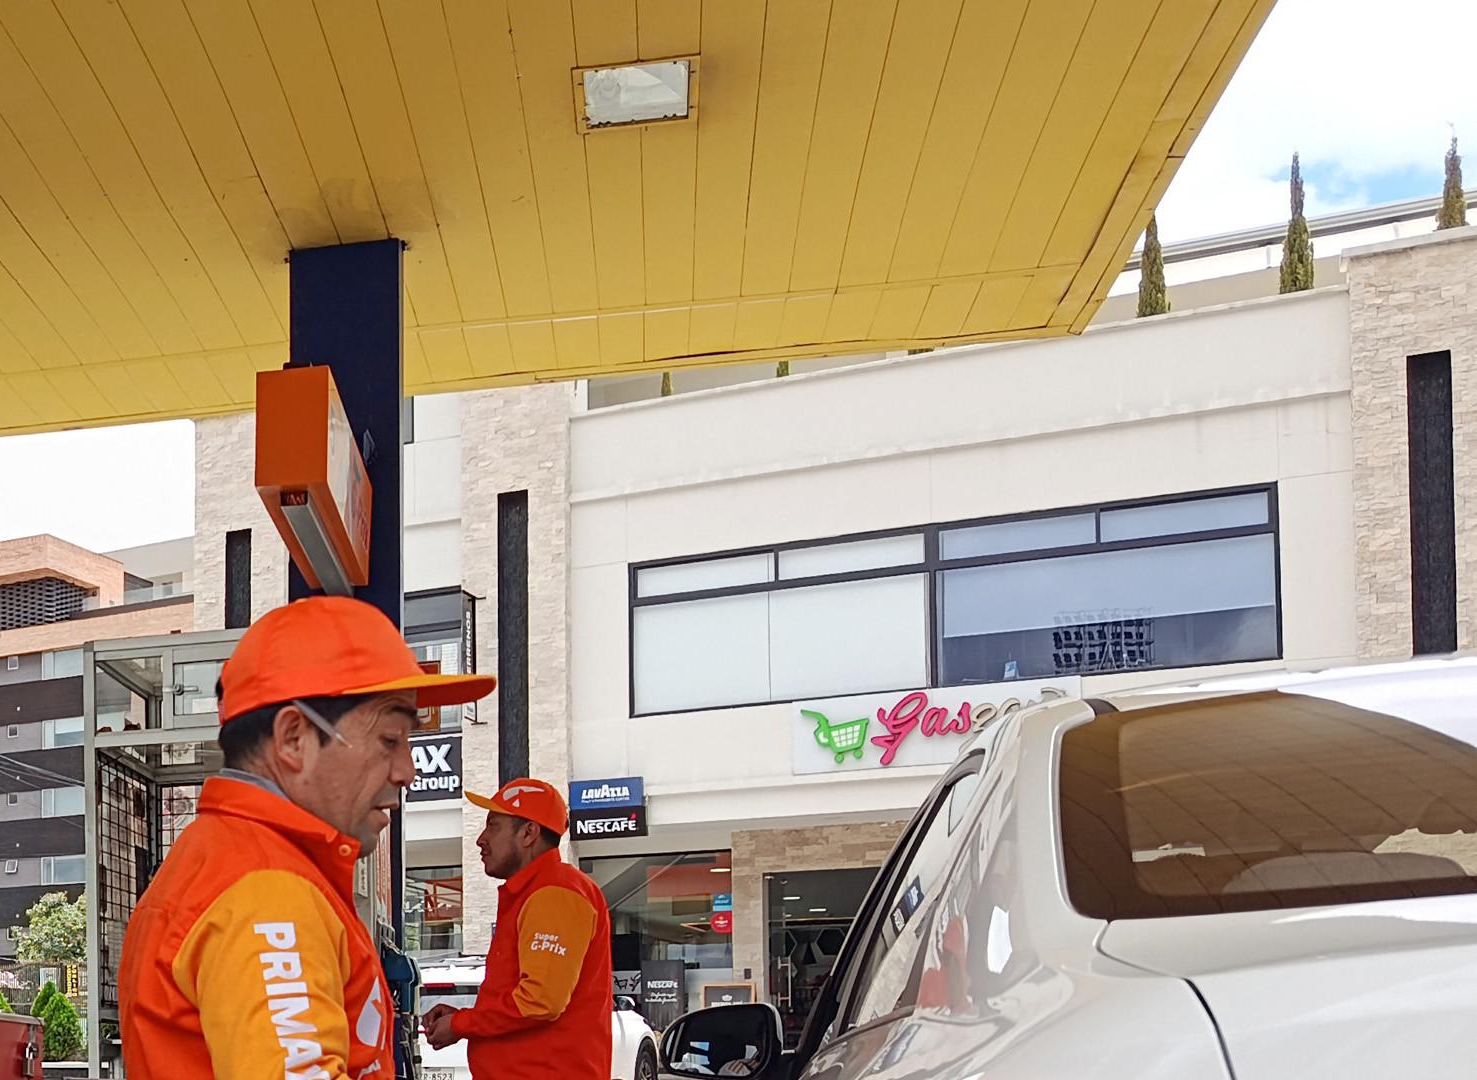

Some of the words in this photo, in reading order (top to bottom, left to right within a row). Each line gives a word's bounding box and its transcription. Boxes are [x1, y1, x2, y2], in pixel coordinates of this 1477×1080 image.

[409, 774, 460, 792] Group
[581, 784, 630, 800] LAVAZZA
[530, 940, 567, 957] G-Prix
